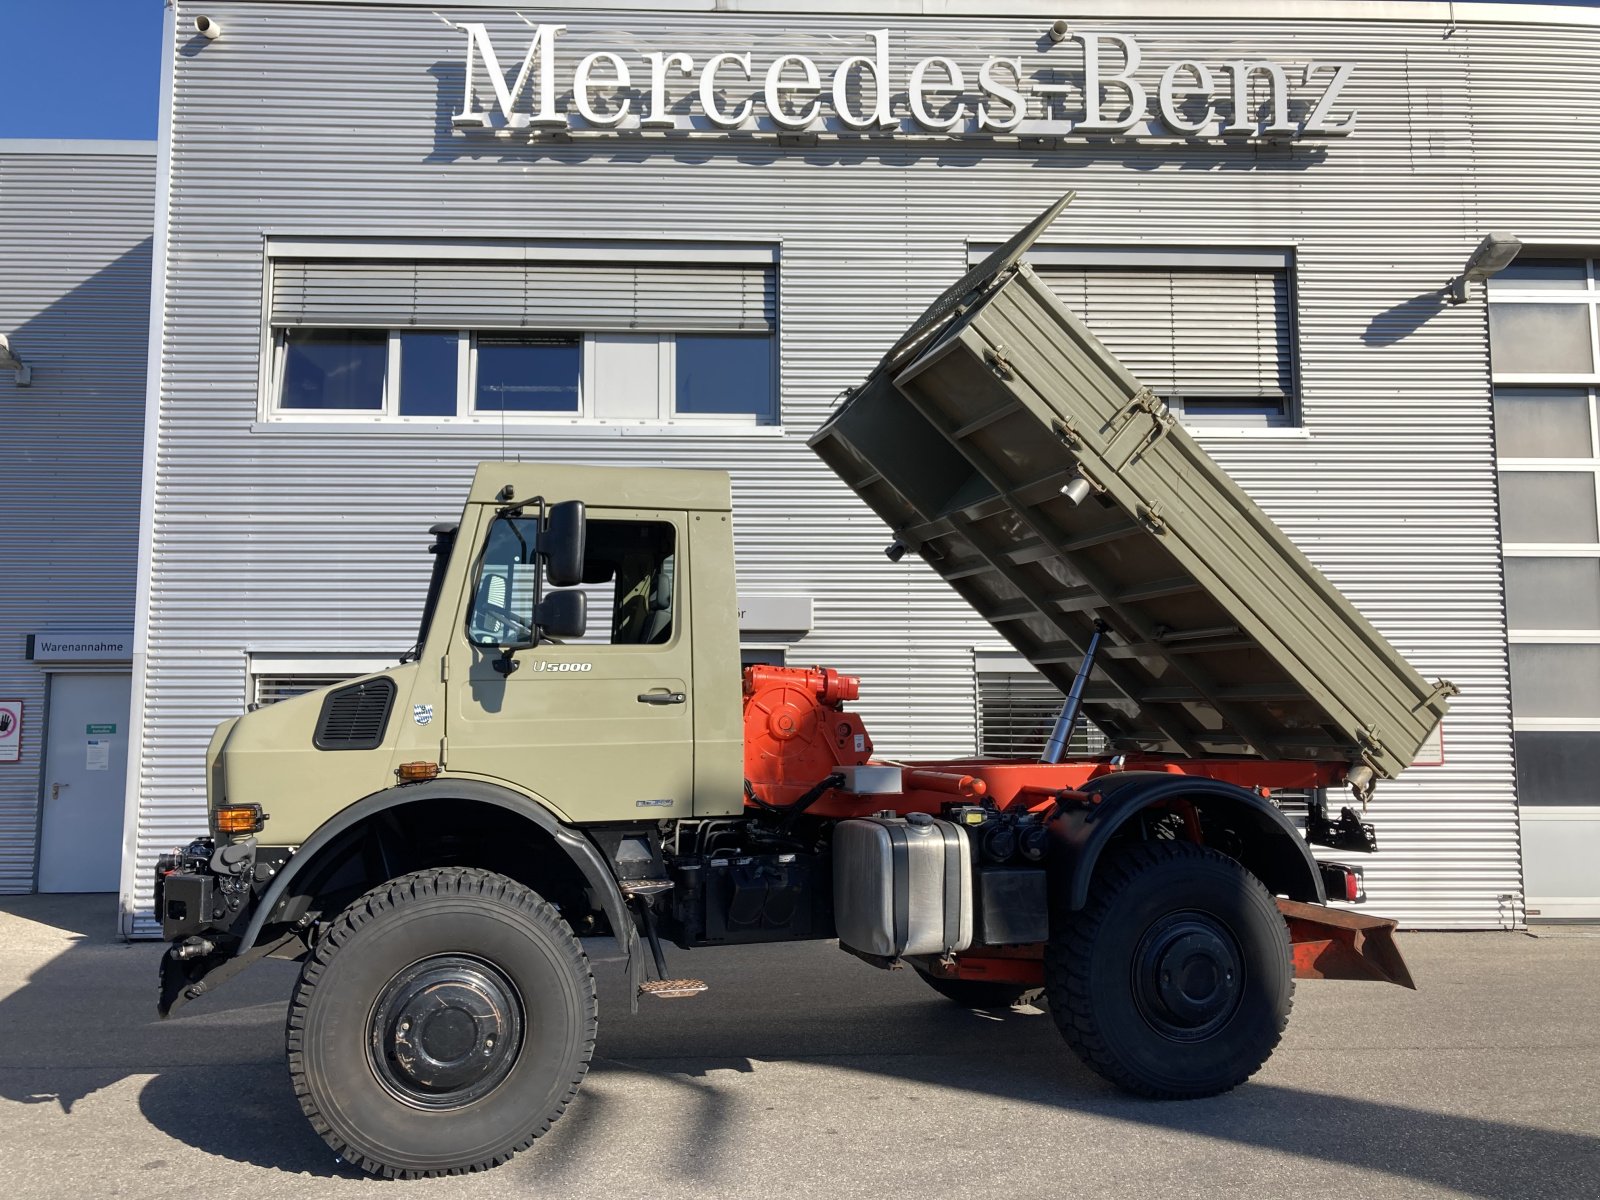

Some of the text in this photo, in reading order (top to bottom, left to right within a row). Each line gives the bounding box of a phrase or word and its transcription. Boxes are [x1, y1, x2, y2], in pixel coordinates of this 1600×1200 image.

[451, 22, 1358, 135] Mercedes-Benz
[41, 642, 124, 652] Warenannahme
[533, 660, 592, 672] U5000
